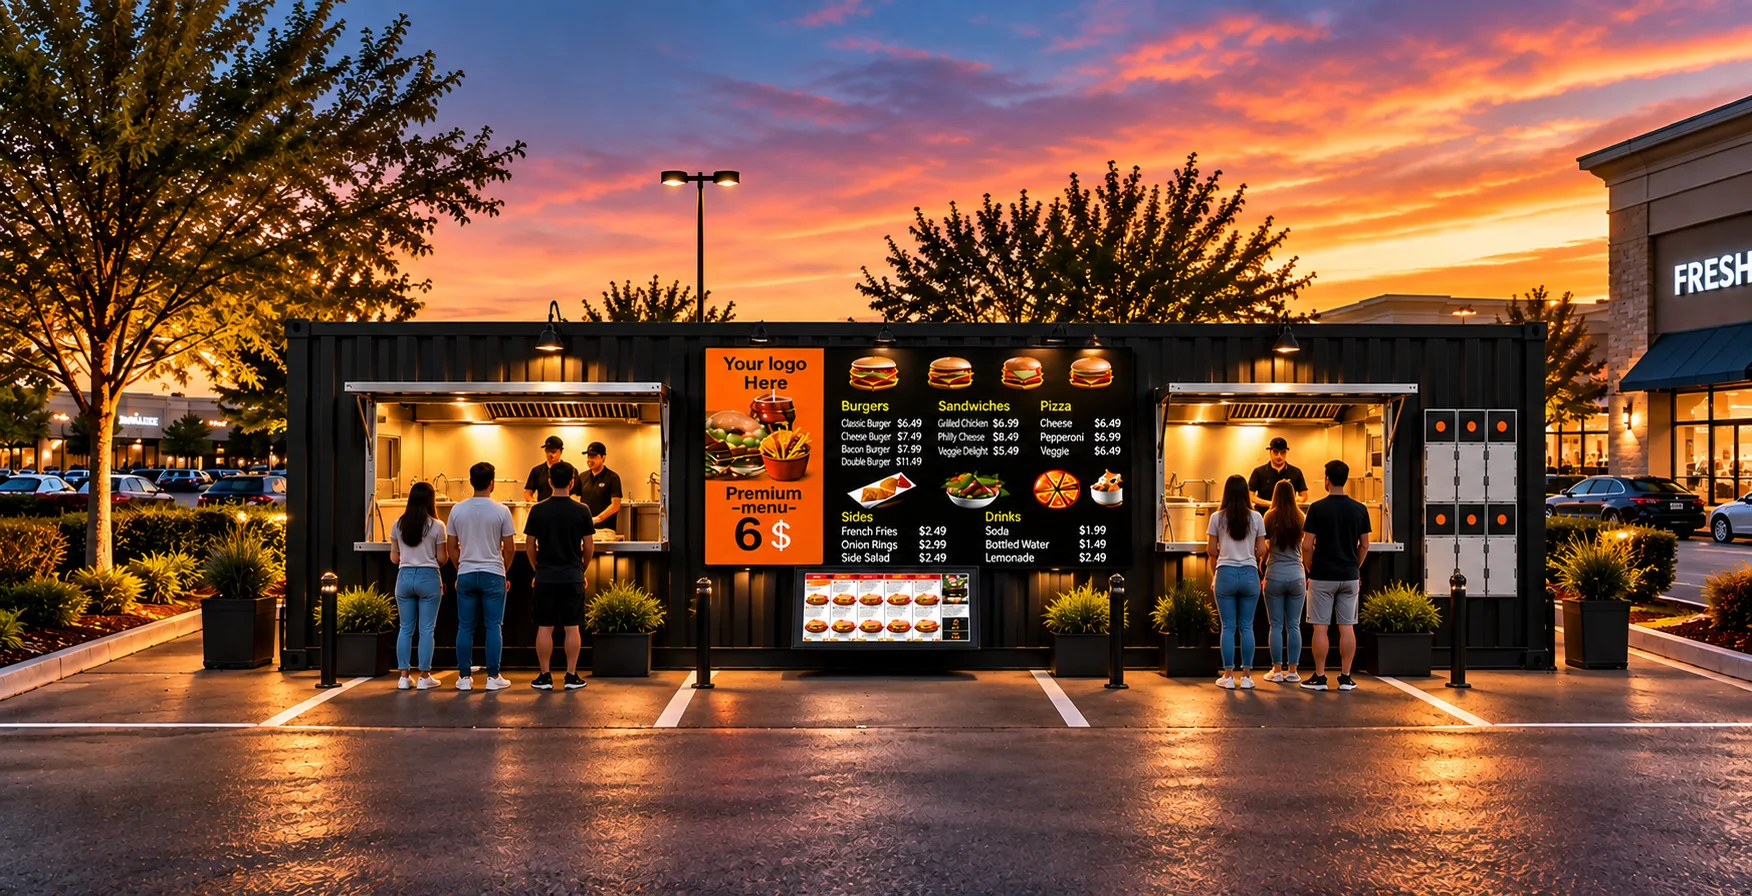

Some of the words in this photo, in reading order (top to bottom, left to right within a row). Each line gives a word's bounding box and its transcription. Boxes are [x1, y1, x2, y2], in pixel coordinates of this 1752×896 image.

[1674, 250, 1752, 296] FRESH
[723, 357, 764, 370] Your
[769, 356, 806, 373] logo
[745, 376, 787, 389] Here
[841, 400, 889, 414] Burgers
[938, 400, 1010, 411] Sandwiches
[1040, 400, 1071, 411] Pizza
[841, 419, 866, 428] Classic
[866, 419, 891, 430] Burger
[897, 419, 922, 429] $6.49
[937, 419, 961, 428] Grilled
[992, 419, 1019, 429] $6.99
[1039, 418, 1072, 428] Cheese
[1094, 418, 1121, 428] $6.49
[897, 432, 921, 442] $7.49
[992, 432, 1019, 442] $8.49
[1040, 432, 1084, 443] Pepperoni
[1094, 432, 1121, 442] $6.99
[841, 445, 864, 455] Bacon
[865, 445, 890, 456] Burger
[897, 445, 921, 454] $7.99
[962, 446, 988, 457] Delight
[992, 446, 1019, 456] $5.49
[1094, 446, 1121, 456] $6.49
[841, 457, 866, 467] Double
[866, 457, 890, 468] Burger
[895, 457, 922, 467] $11.49
[727, 486, 801, 500] Premium
[841, 511, 873, 522] Sides
[985, 511, 1021, 522] Drinks
[735, 517, 762, 551] 6
[771, 519, 791, 552] $
[841, 526, 873, 536] French
[875, 526, 897, 536] Fries
[918, 526, 946, 536] $2.49
[985, 526, 1009, 536] Soda
[1079, 525, 1106, 535] $1.99
[840, 540, 870, 550] Onion
[918, 540, 946, 550] $2.99
[985, 540, 1019, 550] Bottled
[1020, 540, 1049, 550] Water
[1079, 539, 1106, 549] $1.49
[841, 553, 861, 563] Side
[864, 553, 890, 563] Salad
[918, 553, 946, 563] $2.49
[985, 553, 1034, 563] Lemonade
[1079, 553, 1106, 563] $2.49
